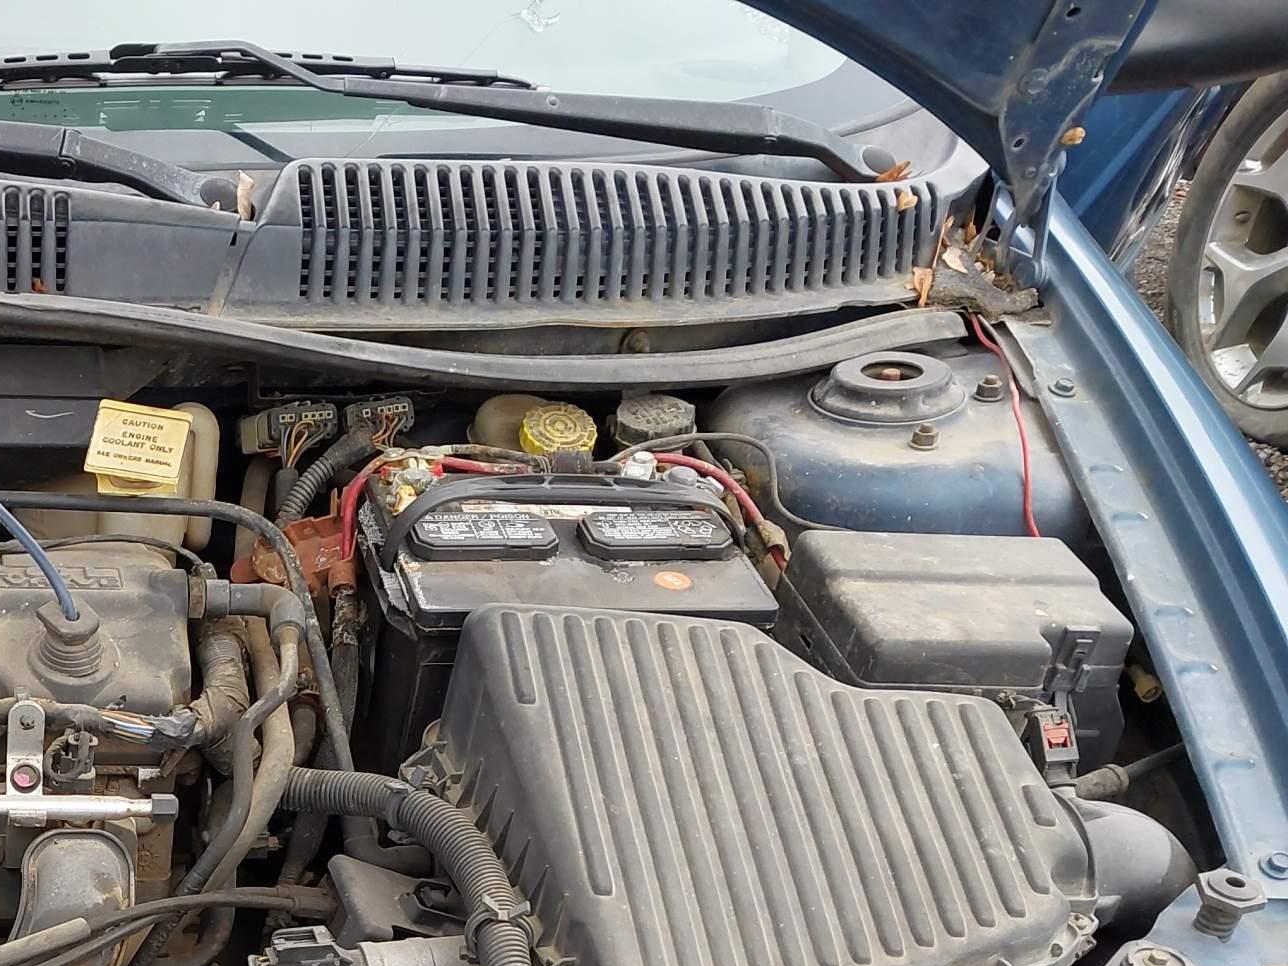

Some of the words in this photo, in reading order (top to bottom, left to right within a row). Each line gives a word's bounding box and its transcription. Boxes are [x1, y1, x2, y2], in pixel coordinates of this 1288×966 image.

[122, 418, 164, 431] CAUTION
[122, 431, 159, 443] ENGINE
[102, 436, 146, 449] COOLANT
[149, 443, 174, 454] ONLY
